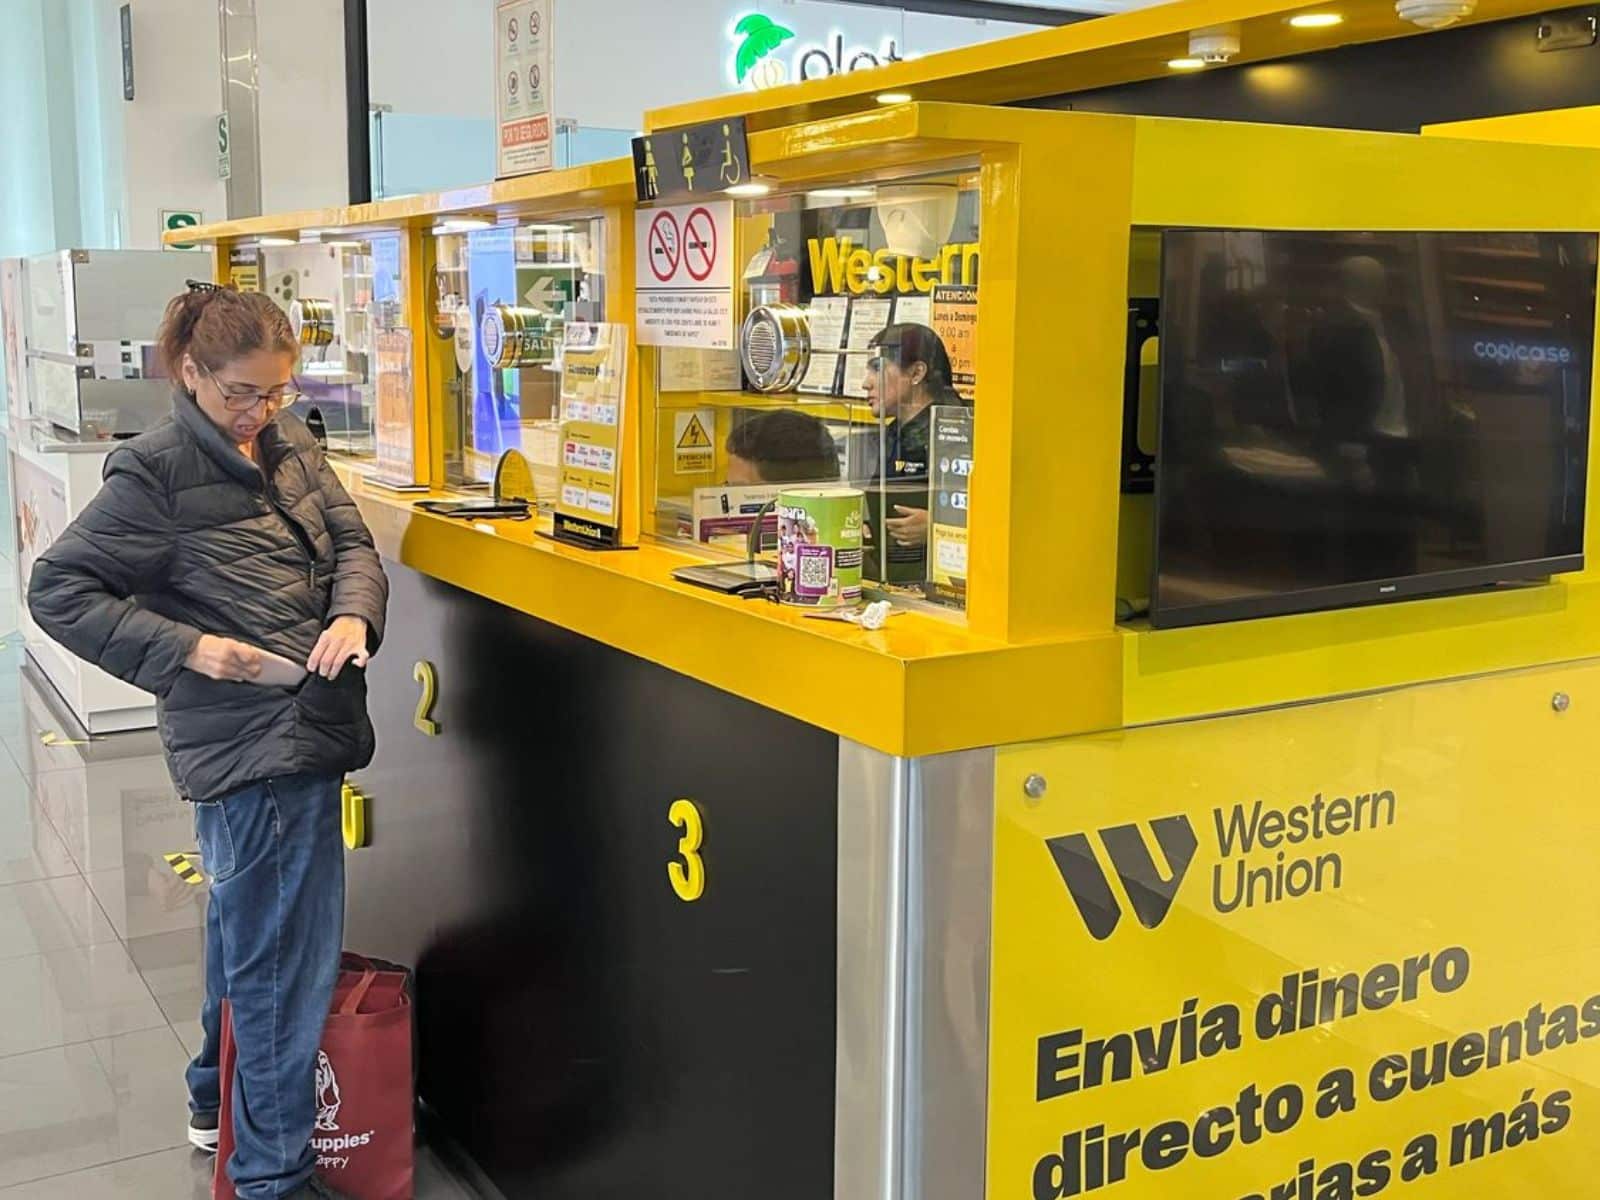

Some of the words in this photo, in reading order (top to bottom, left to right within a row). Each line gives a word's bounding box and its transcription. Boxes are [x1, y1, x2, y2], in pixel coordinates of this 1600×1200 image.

[413, 660, 435, 736] 2
[667, 799, 705, 902] 3
[1213, 789, 1396, 859] Western
[1212, 851, 1342, 914] Union
[1035, 998, 1242, 1102] Envía
[1254, 946, 1471, 1041] dinero
[1031, 1080, 1304, 1200] directo
[1315, 1067, 1357, 1119] a
[1368, 994, 1600, 1103] cuentas
[1400, 1132, 1438, 1183] a
[1449, 1088, 1573, 1168] más
